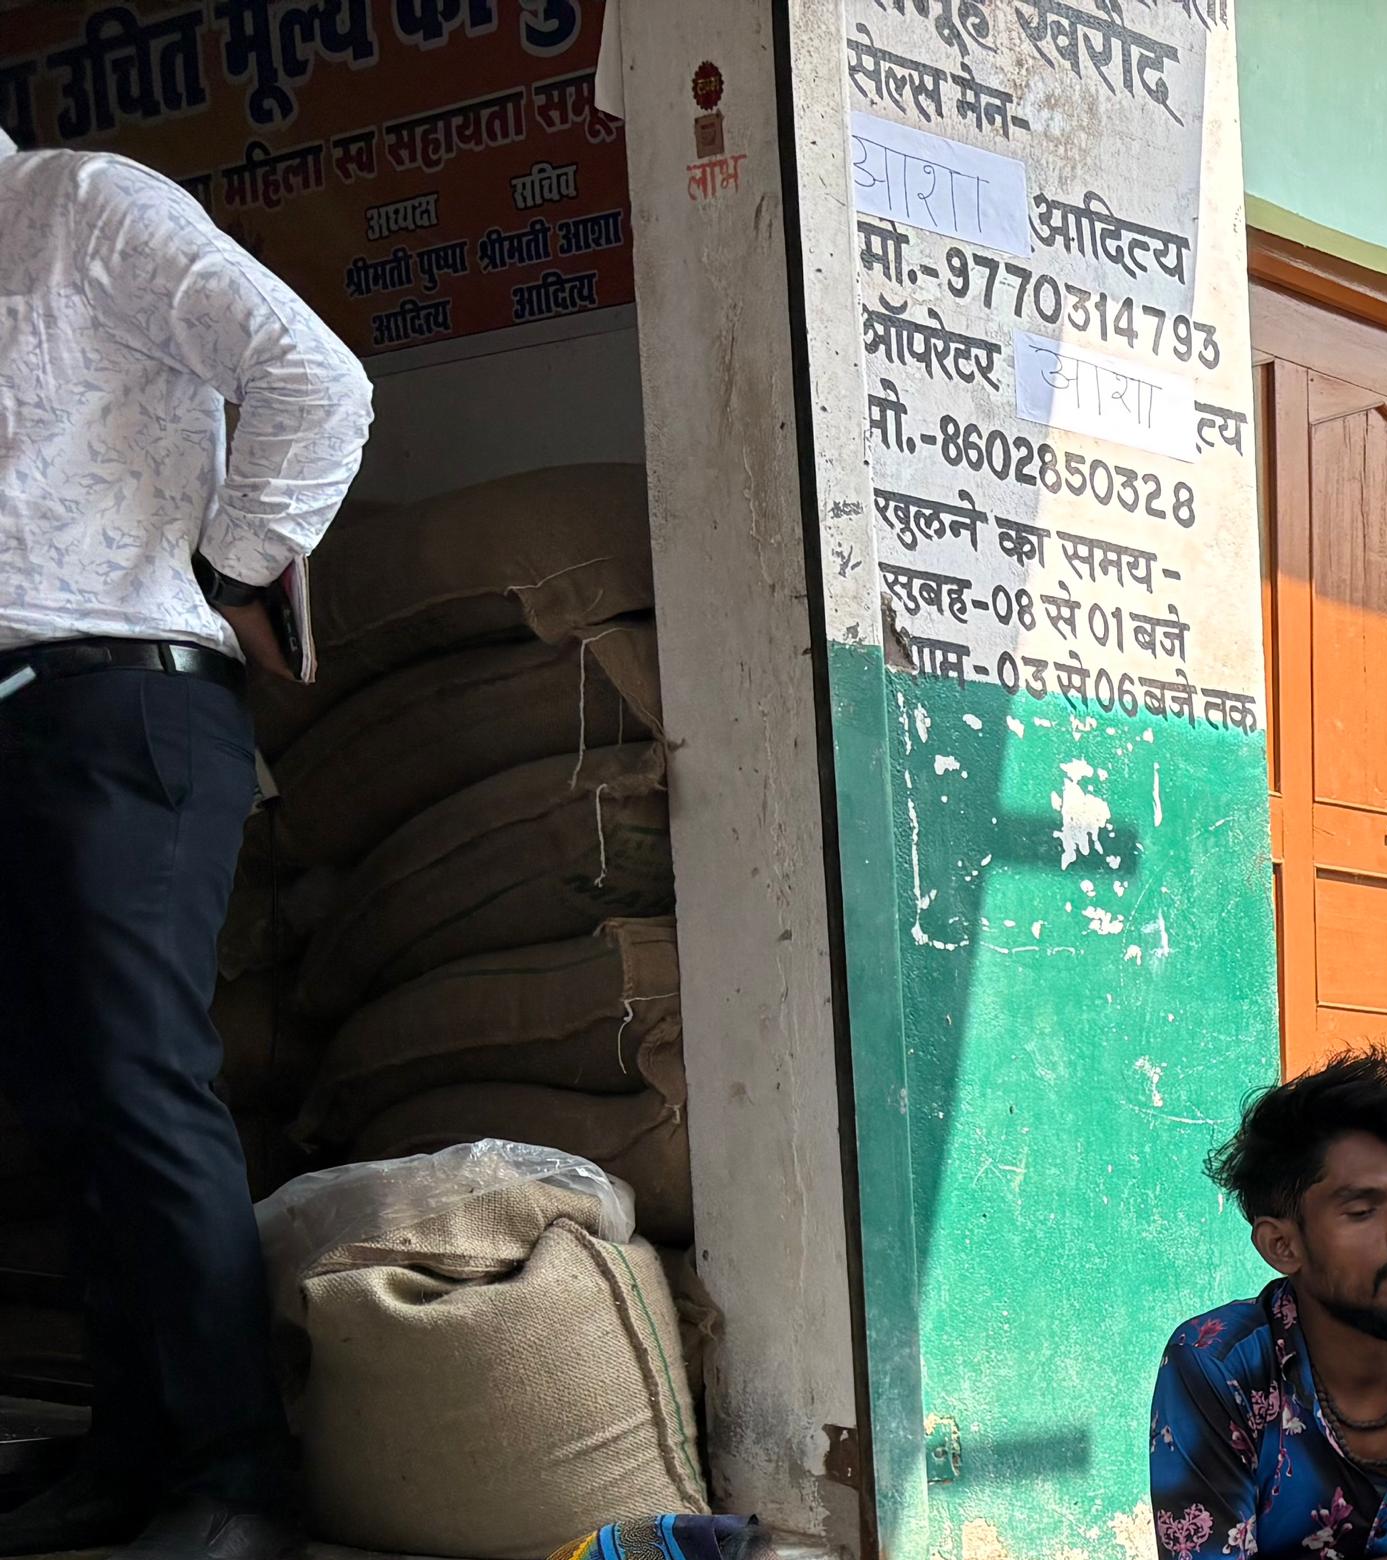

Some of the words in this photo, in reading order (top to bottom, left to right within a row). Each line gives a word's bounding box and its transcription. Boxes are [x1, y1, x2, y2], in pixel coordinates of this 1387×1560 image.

[47, 7, 206, 140] उचित
[846, 22, 948, 123] सेल्स
[222, 141, 323, 209] महिला
[333, 132, 375, 183] स्व
[386, 91, 524, 172] सहायता
[535, 73, 623, 144] समू
[686, 154, 747, 200] लाभ
[510, 161, 578, 210] सचिव
[851, 134, 990, 233] आशा
[345, 248, 412, 297] श्रीमती
[416, 242, 468, 291] पुष्पा
[479, 218, 551, 271] श्रीमती
[558, 211, 622, 254] आशा
[1030, 190, 1191, 286] आदित्य
[373, 299, 450, 344] आदित्य
[513, 271, 596, 319] आदित्य
[1028, 344, 1163, 429] आशा
[873, 488, 989, 553] खुलने
[994, 515, 1051, 569] का
[1040, 580, 1082, 641] से
[1088, 602, 1126, 654] 01
[1129, 604, 1191, 664] बजे
[1053, 650, 1091, 713] से
[1094, 668, 1139, 719] 06
[1138, 667, 1198, 729] बजे
[1200, 688, 1258, 737] तक
